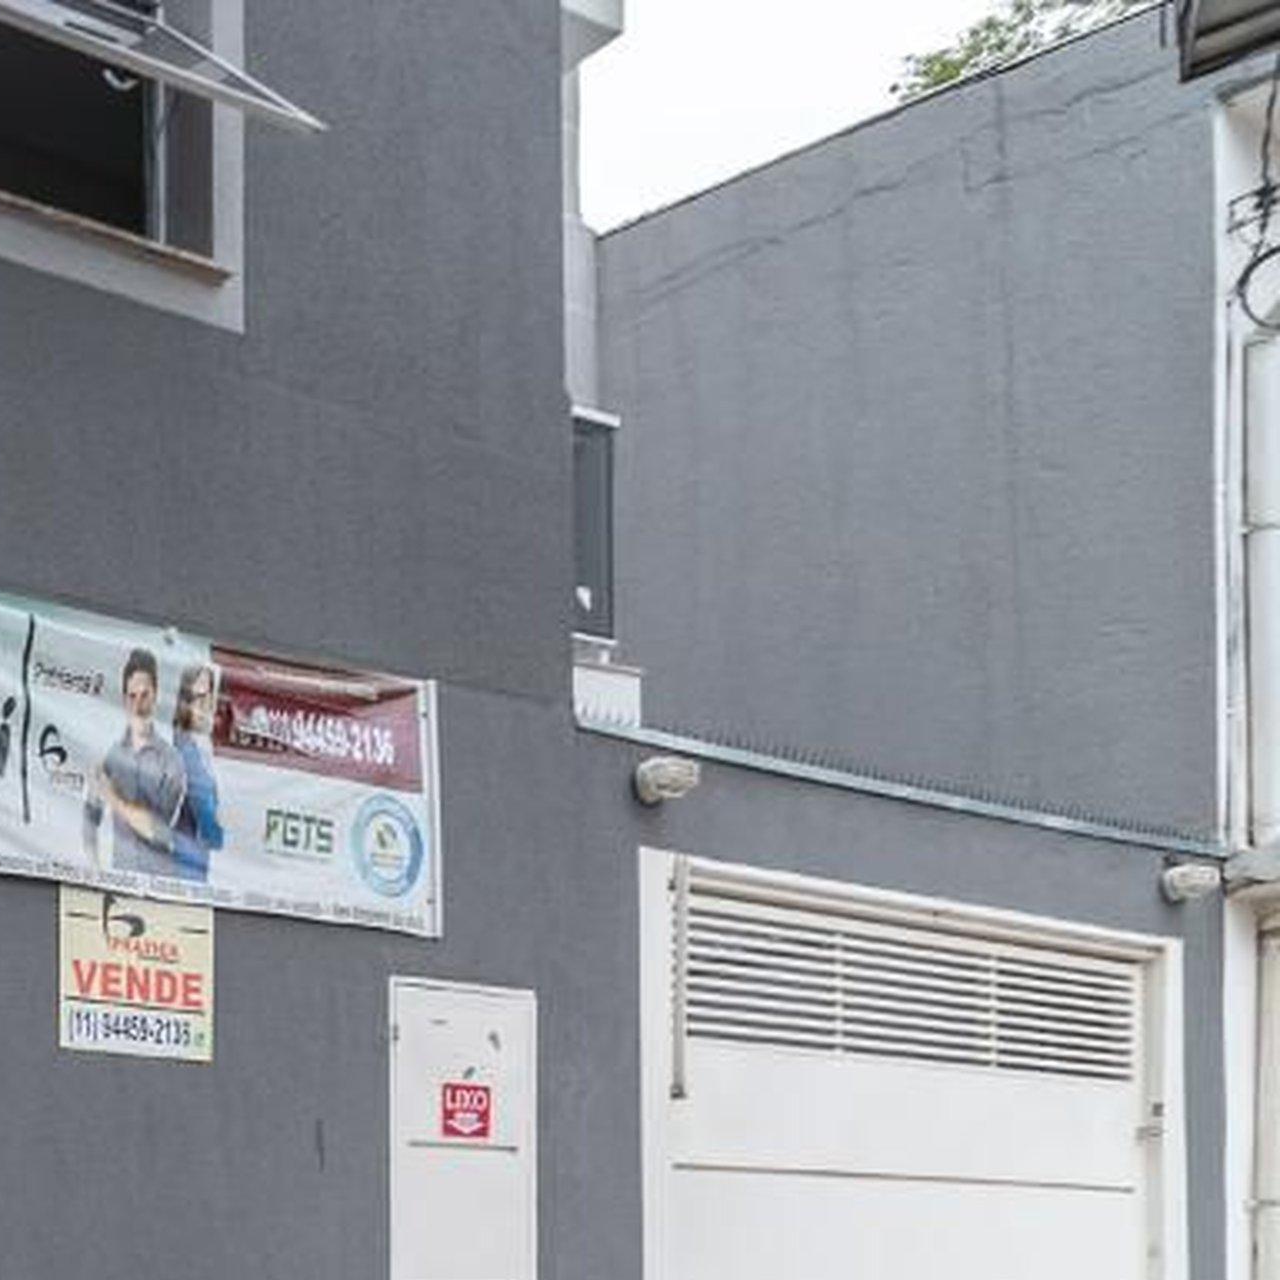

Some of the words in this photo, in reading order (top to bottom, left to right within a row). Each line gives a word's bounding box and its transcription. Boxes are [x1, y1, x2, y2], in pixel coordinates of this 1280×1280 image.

[264, 808, 334, 854] FGTS
[72, 959, 203, 1007] VENDE
[445, 1089, 488, 1112] LIXO
